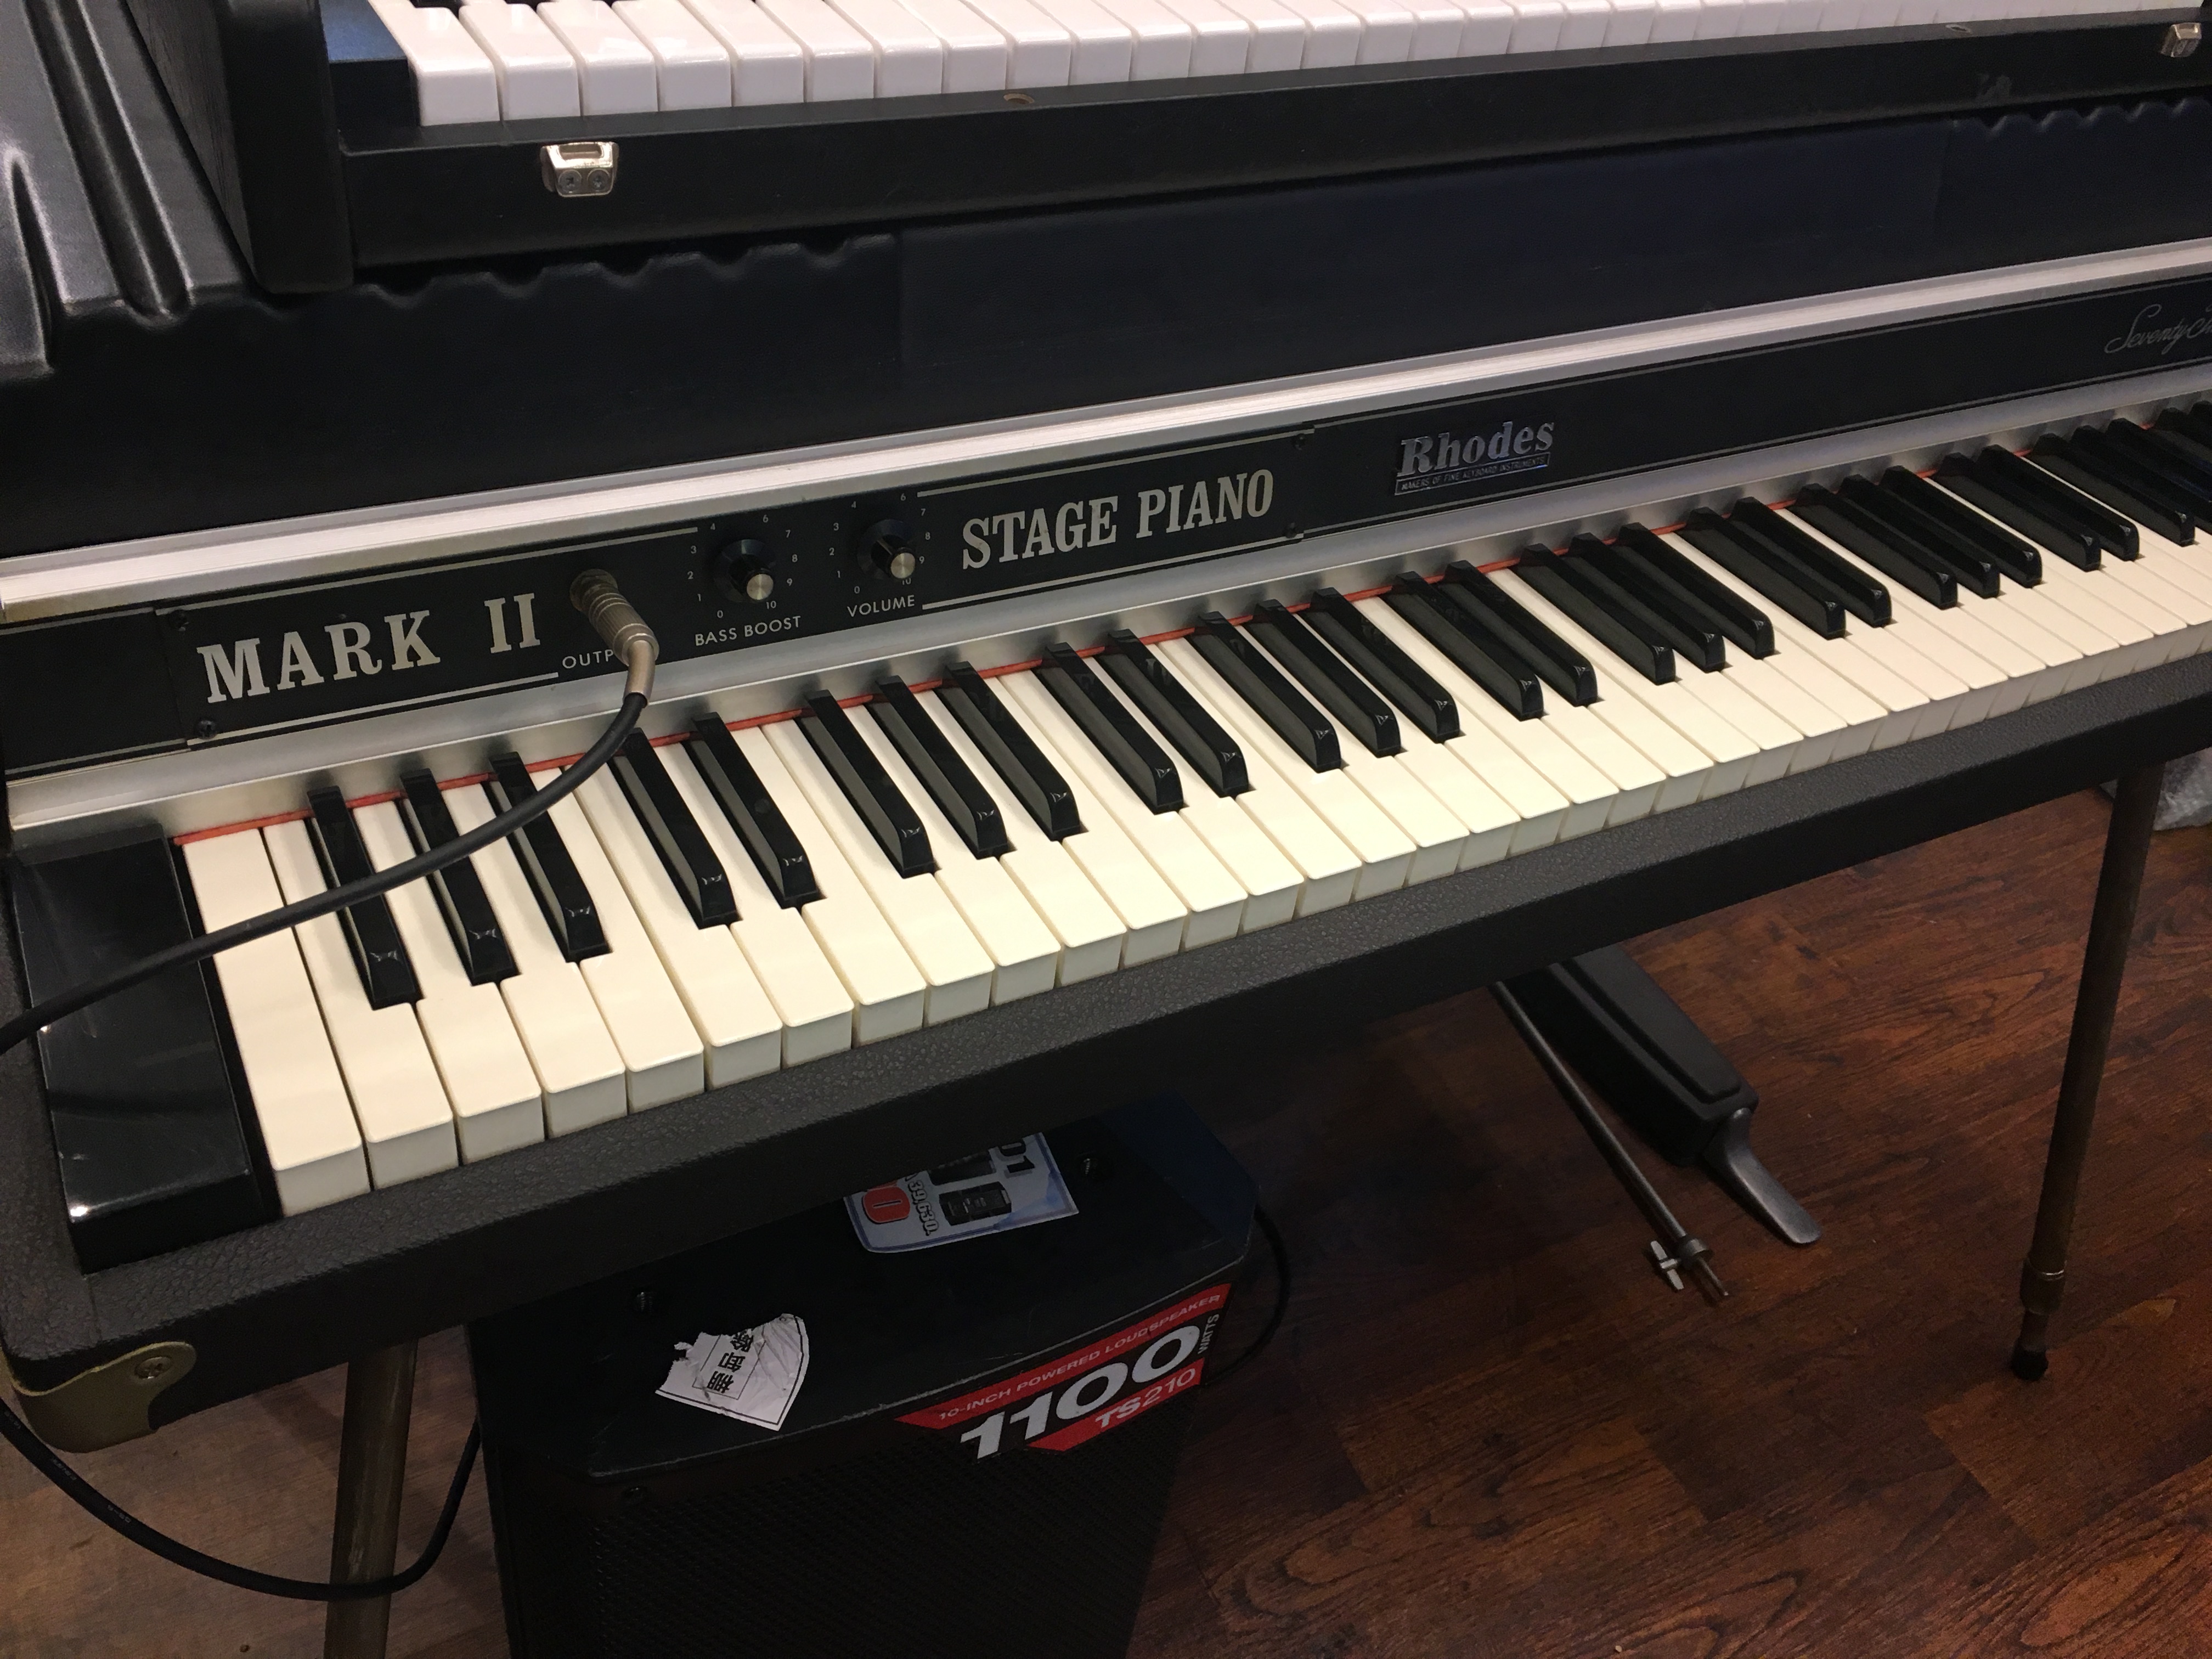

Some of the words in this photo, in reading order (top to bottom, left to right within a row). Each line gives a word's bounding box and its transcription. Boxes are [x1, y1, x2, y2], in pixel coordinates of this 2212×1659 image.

[2104, 303, 2188, 355] Seventy
[1397, 421, 1555, 477] Rhodes
[1401, 478, 1430, 491] MAKERS
[1432, 476, 1442, 484] OF
[1444, 472, 1460, 482] FINE
[1462, 465, 1497, 479] KEYBOARD
[900, 493, 906, 501] 6
[851, 501, 857, 509] 4
[921, 508, 926, 516] 7
[763, 515, 769, 523] 6
[962, 495, 1118, 569] STAGE
[1136, 469, 1274, 539] PIANO
[833, 522, 839, 531] 3
[785, 529, 792, 538] 7
[925, 532, 931, 540] 8
[690, 545, 697, 554] 3
[829, 547, 835, 556] 2
[792, 554, 798, 562] 8
[919, 556, 925, 564] 9
[687, 571, 693, 580] 2
[787, 578, 793, 586] 9
[854, 586, 860, 594] 0
[697, 593, 702, 601] 1
[766, 600, 777, 610] 10
[847, 595, 915, 617] VOLUME
[717, 610, 724, 618] 0
[695, 628, 737, 646] BASS
[744, 616, 801, 637] BOOST
[196, 610, 441, 703] MARK
[484, 593, 541, 653] II
[562, 649, 614, 669] OUTP
[939, 1387, 1011, 1420] 10-INCH
[1017, 1350, 1101, 1392] POWERED
[1105, 1294, 1221, 1354] LOUDSPEAKER
[960, 1325, 1200, 1459] 1100
[1198, 1313, 1219, 1355] WATTS
[1096, 1368, 1195, 1427] TS210
